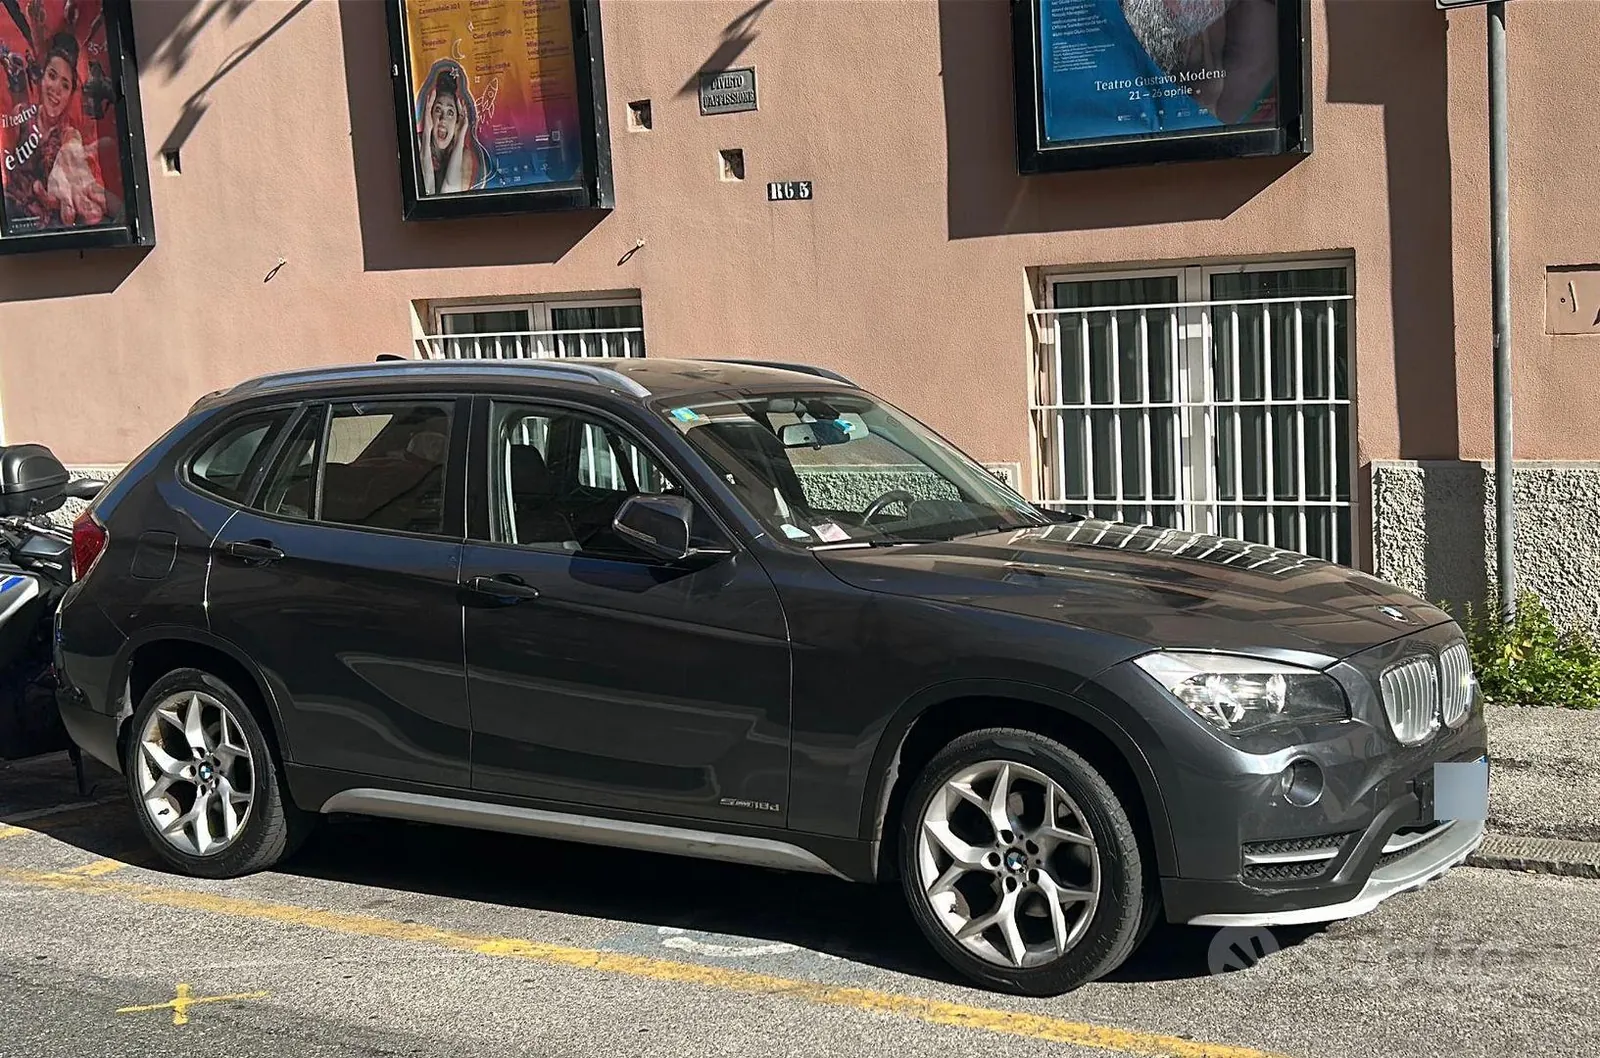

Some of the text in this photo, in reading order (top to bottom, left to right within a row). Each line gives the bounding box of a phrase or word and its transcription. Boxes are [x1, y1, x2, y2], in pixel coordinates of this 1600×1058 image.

[711, 75, 744, 90] DIVIETO
[1094, 68, 1227, 92] Teatro Gustavo Modena
[1129, 90, 1141, 101] 21
[1152, 88, 1162, 98] 26
[1163, 85, 1193, 98] aprile
[2, 104, 37, 128] il teatro
[4, 124, 43, 170] è tuo!
